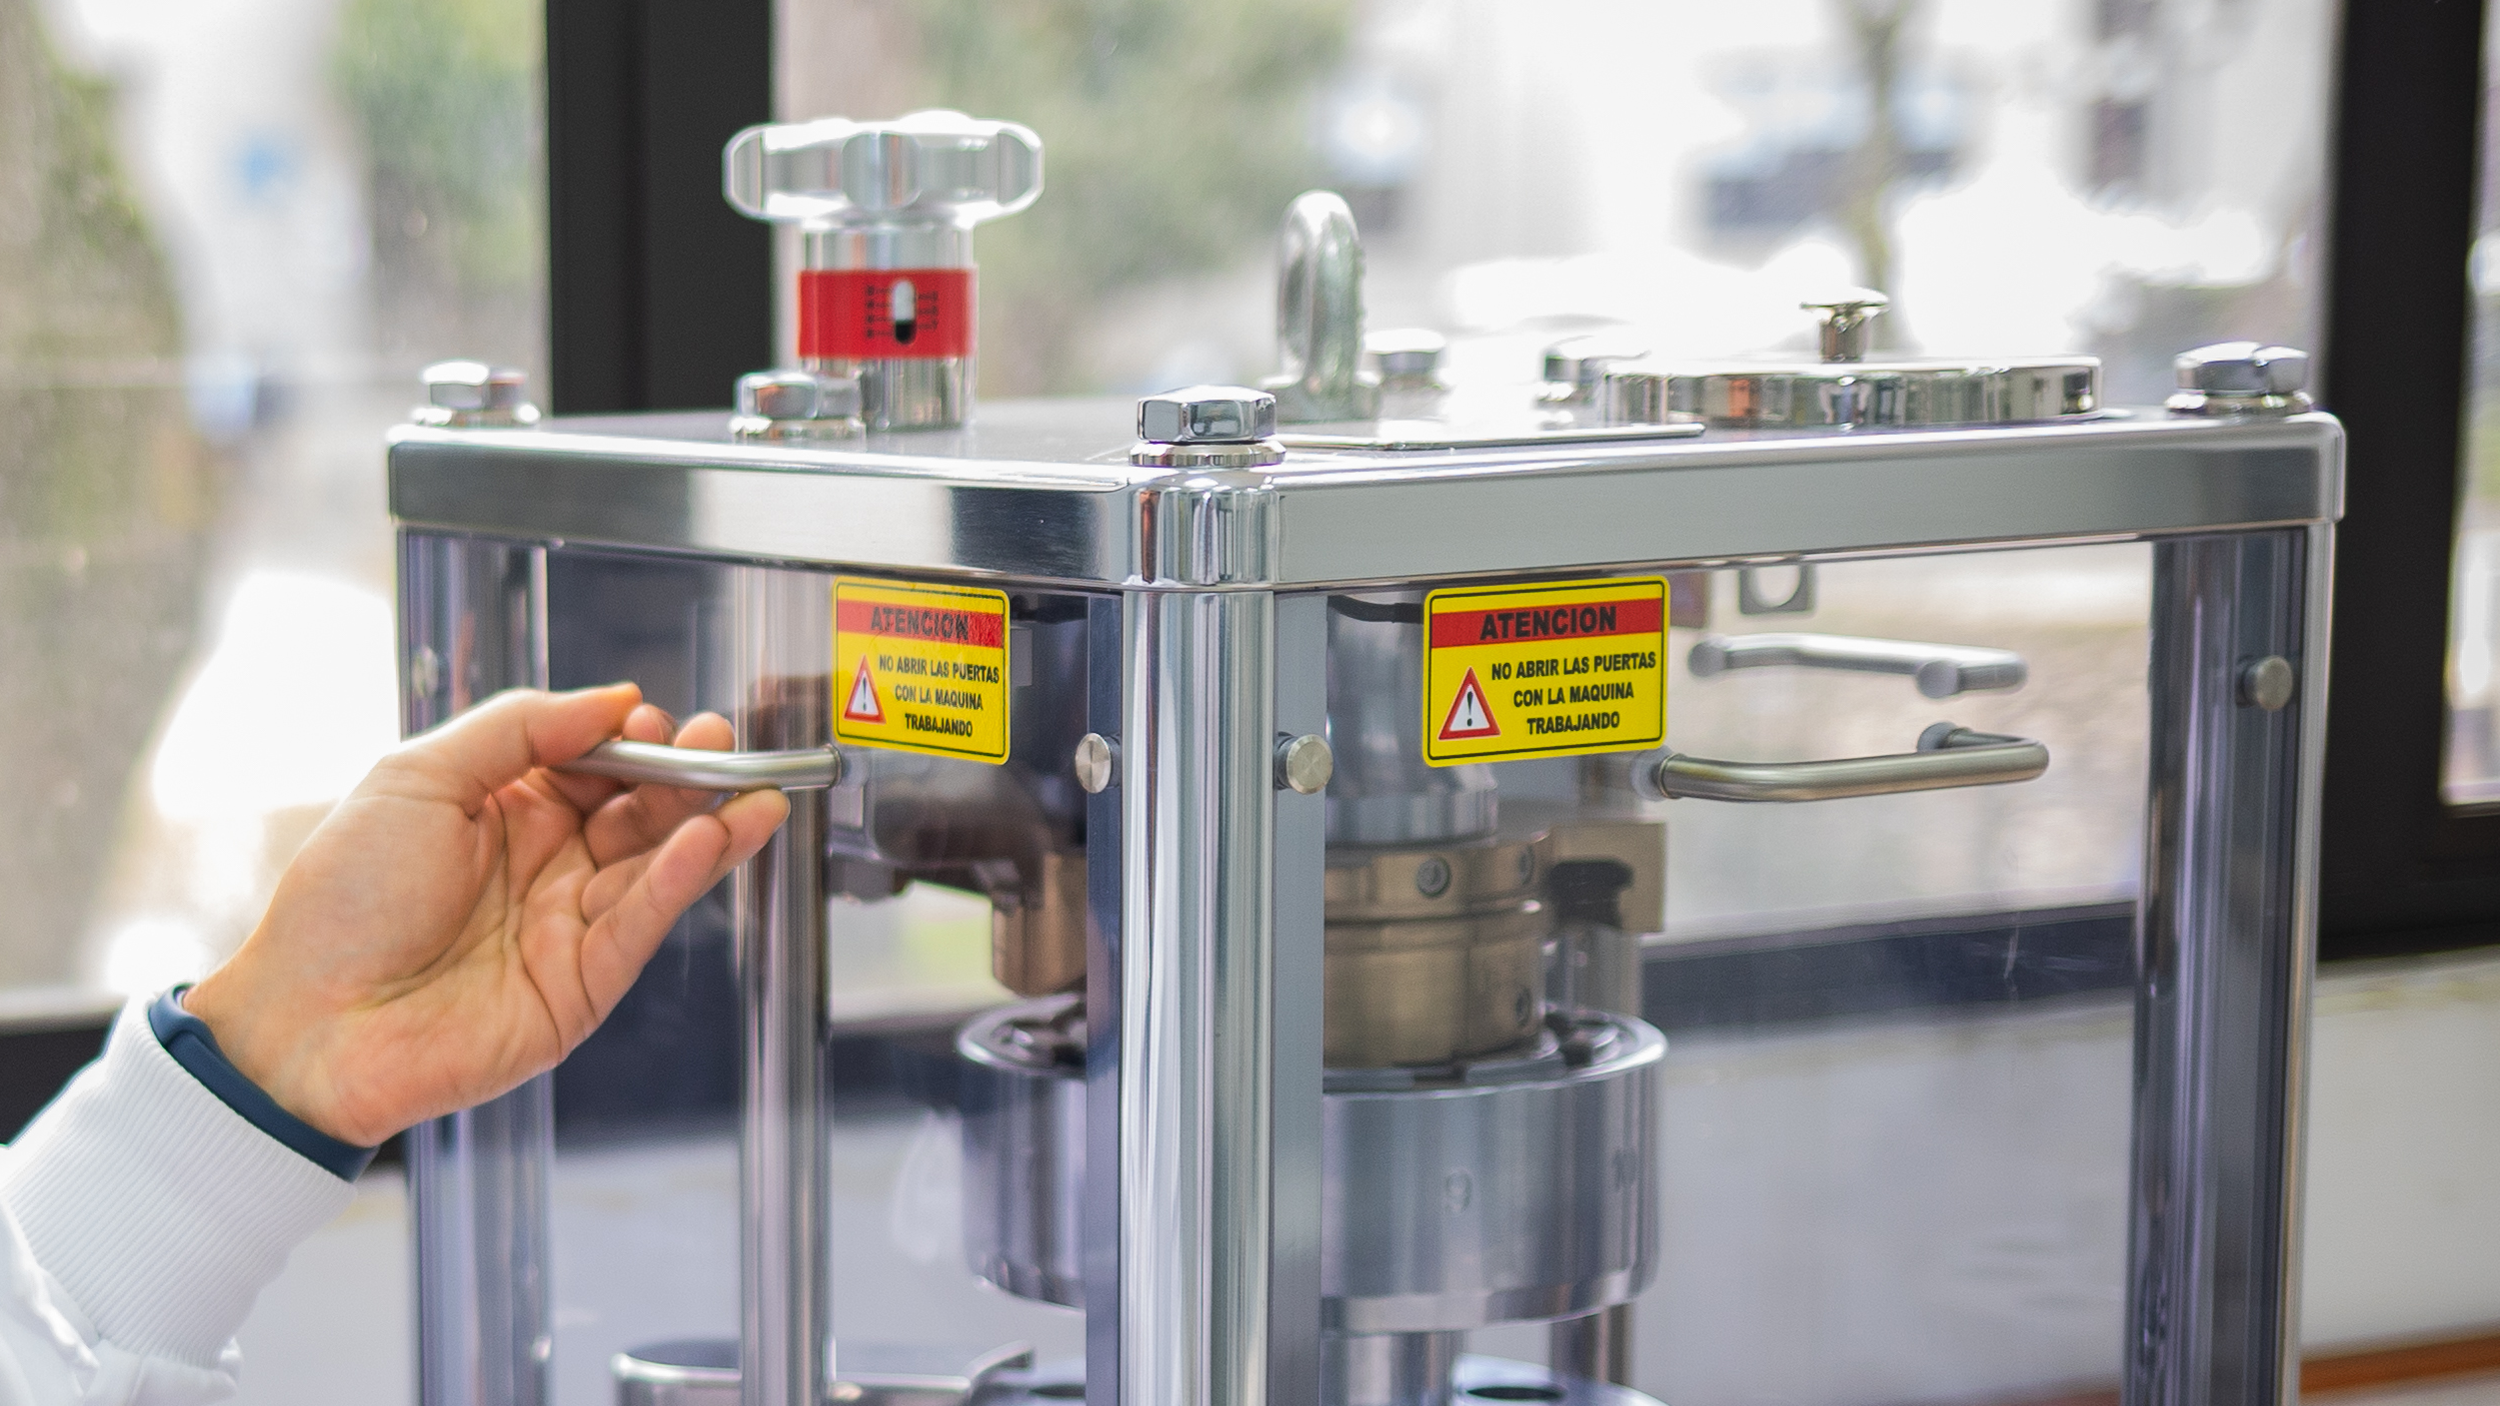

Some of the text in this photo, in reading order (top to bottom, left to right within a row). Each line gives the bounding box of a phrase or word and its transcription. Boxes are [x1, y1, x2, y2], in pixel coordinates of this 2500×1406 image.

[871, 607, 969, 640] ATENCION
[1480, 606, 1617, 640] ATENCION
[879, 655, 999, 683] NO ABRIR LAS PUERTAS
[1491, 652, 1656, 680] NO ABRIR LAS PUERTAS
[895, 685, 983, 710] CON LA MAQUINA
[1513, 682, 1634, 707] CON LA MAQUINA
[905, 713, 972, 737] TRABAJANDO
[1527, 712, 1620, 735] TRABAJANDO
